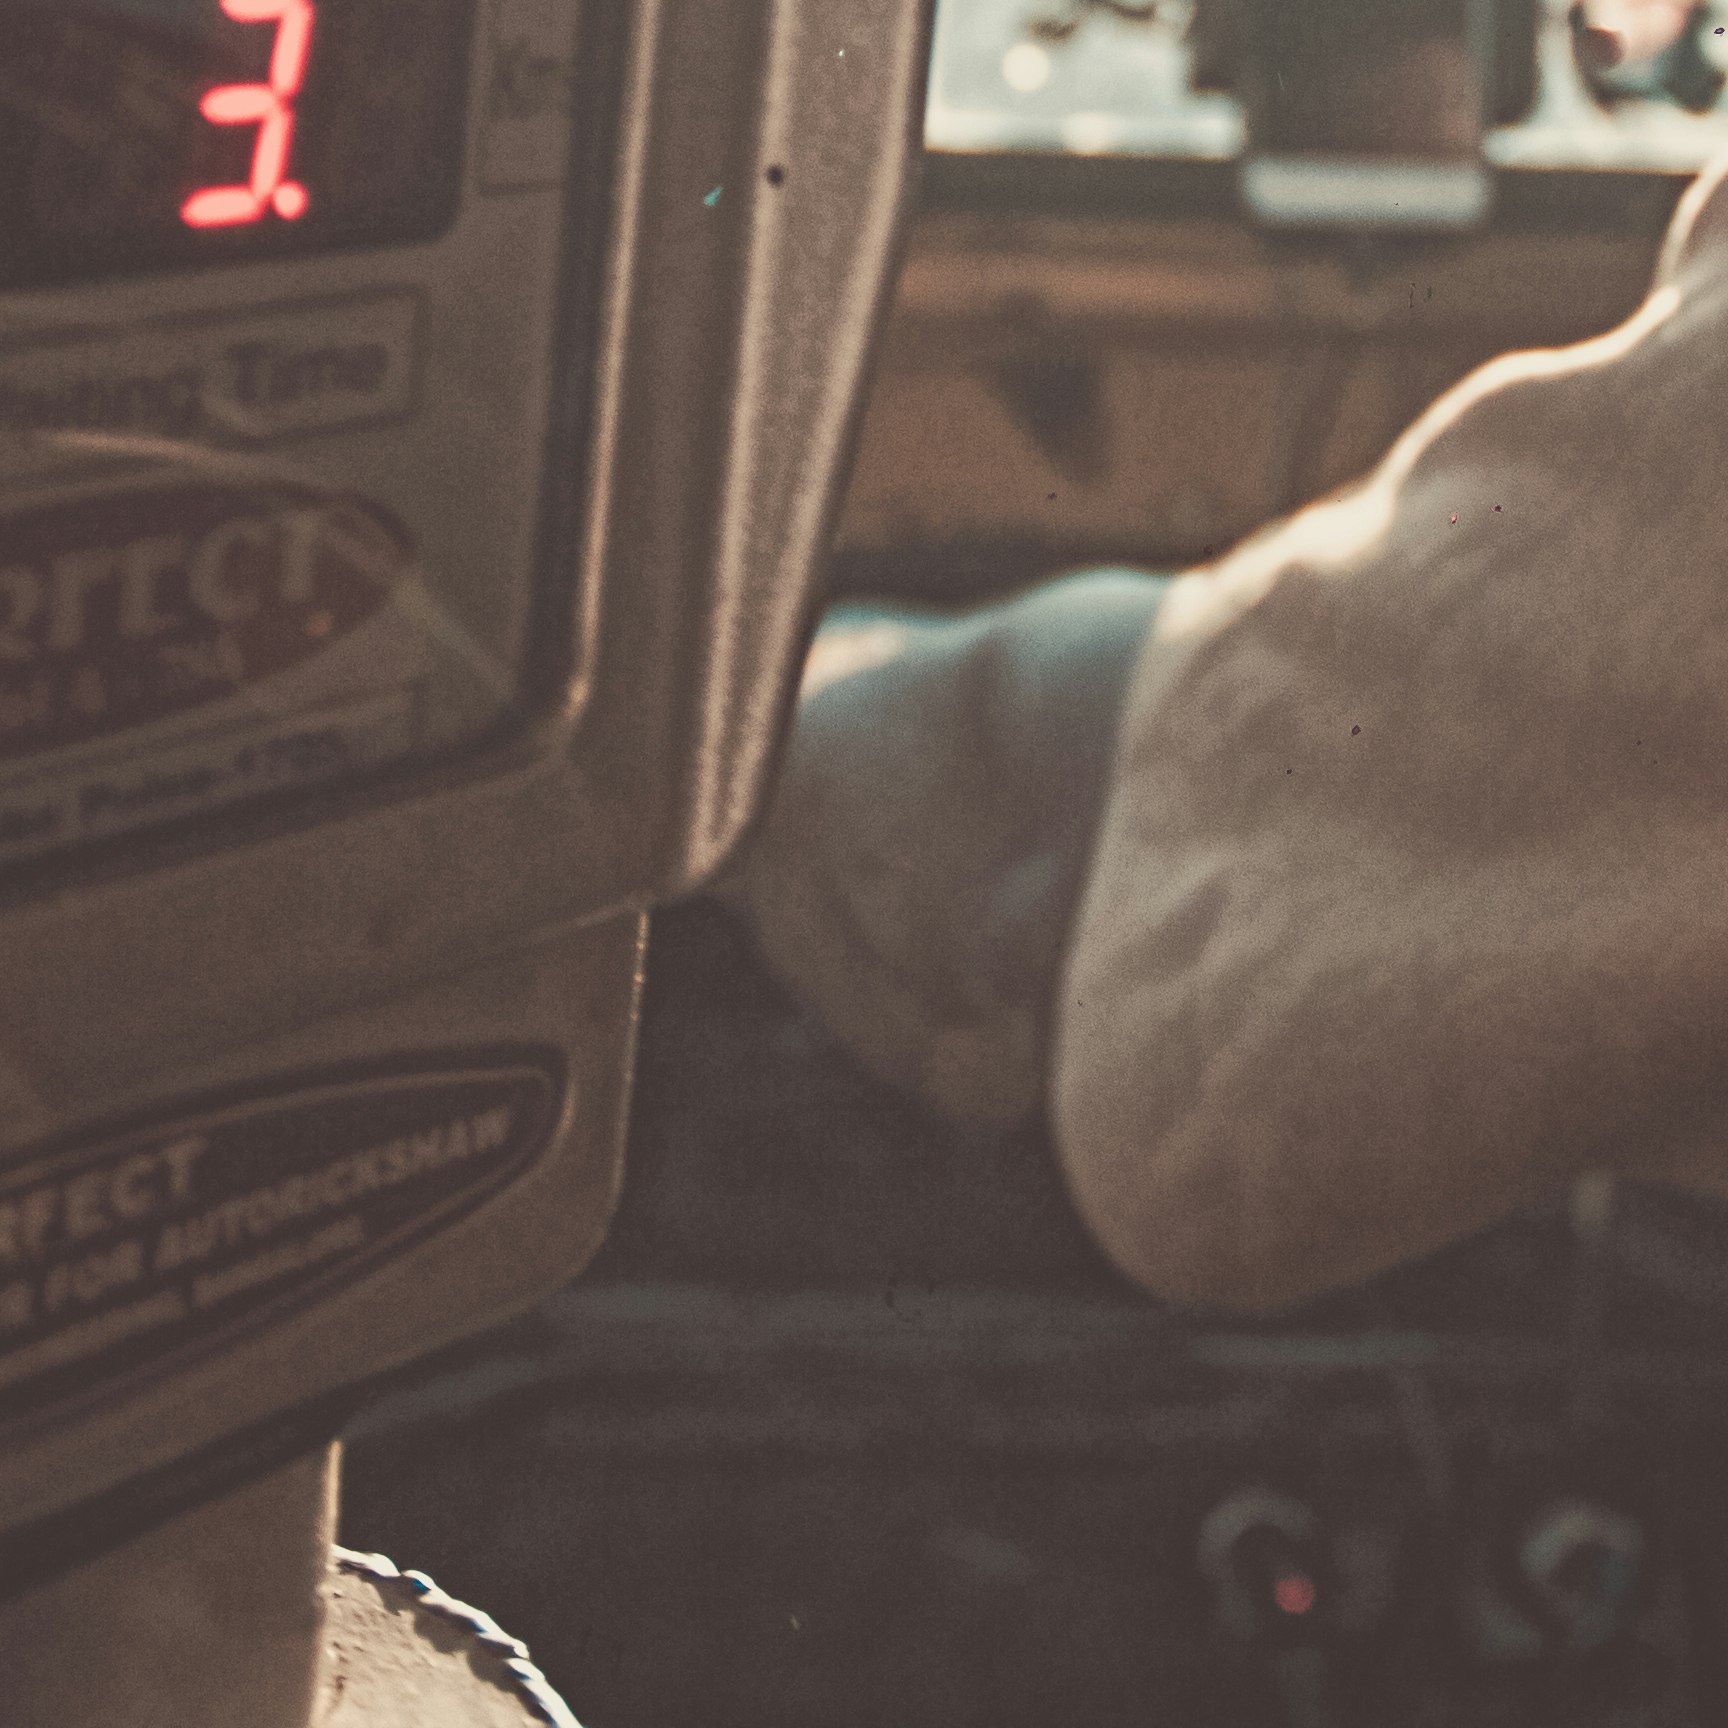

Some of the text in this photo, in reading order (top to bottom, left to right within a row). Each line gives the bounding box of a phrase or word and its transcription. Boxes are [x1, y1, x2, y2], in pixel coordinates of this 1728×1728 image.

[224, 338, 390, 410] Time
[45, 1244, 148, 1331] FOR
[152, 1104, 517, 1272] AUTORICKSHAW
